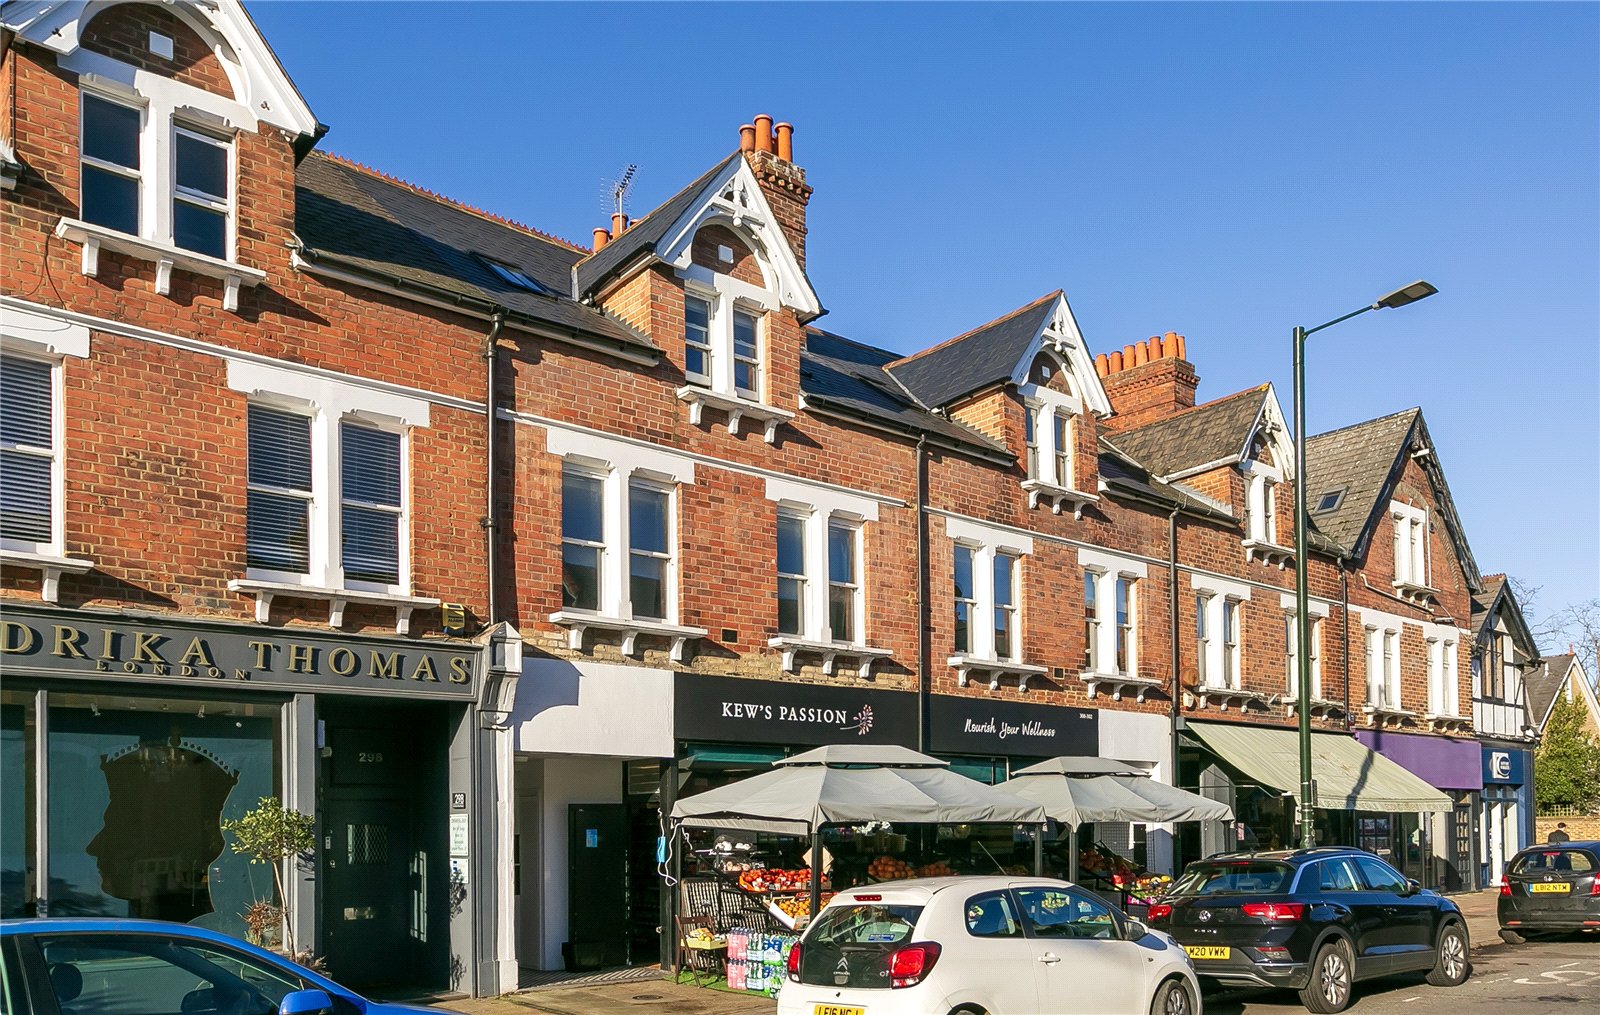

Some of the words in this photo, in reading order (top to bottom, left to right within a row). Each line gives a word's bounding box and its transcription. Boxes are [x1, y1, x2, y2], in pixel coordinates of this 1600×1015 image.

[0, 619, 211, 666] DRIKA
[248, 640, 467, 684] THOMAS
[96, 659, 246, 681] LONDON
[721, 702, 772, 720] KEW'S
[779, 706, 847, 725] PASSION
[964, 717, 997, 734] Nourish
[999, 721, 1020, 739] Your
[1022, 720, 1056, 737] Wellness
[359, 752, 383, 762] 298
[1187, 947, 1206, 957] M20
